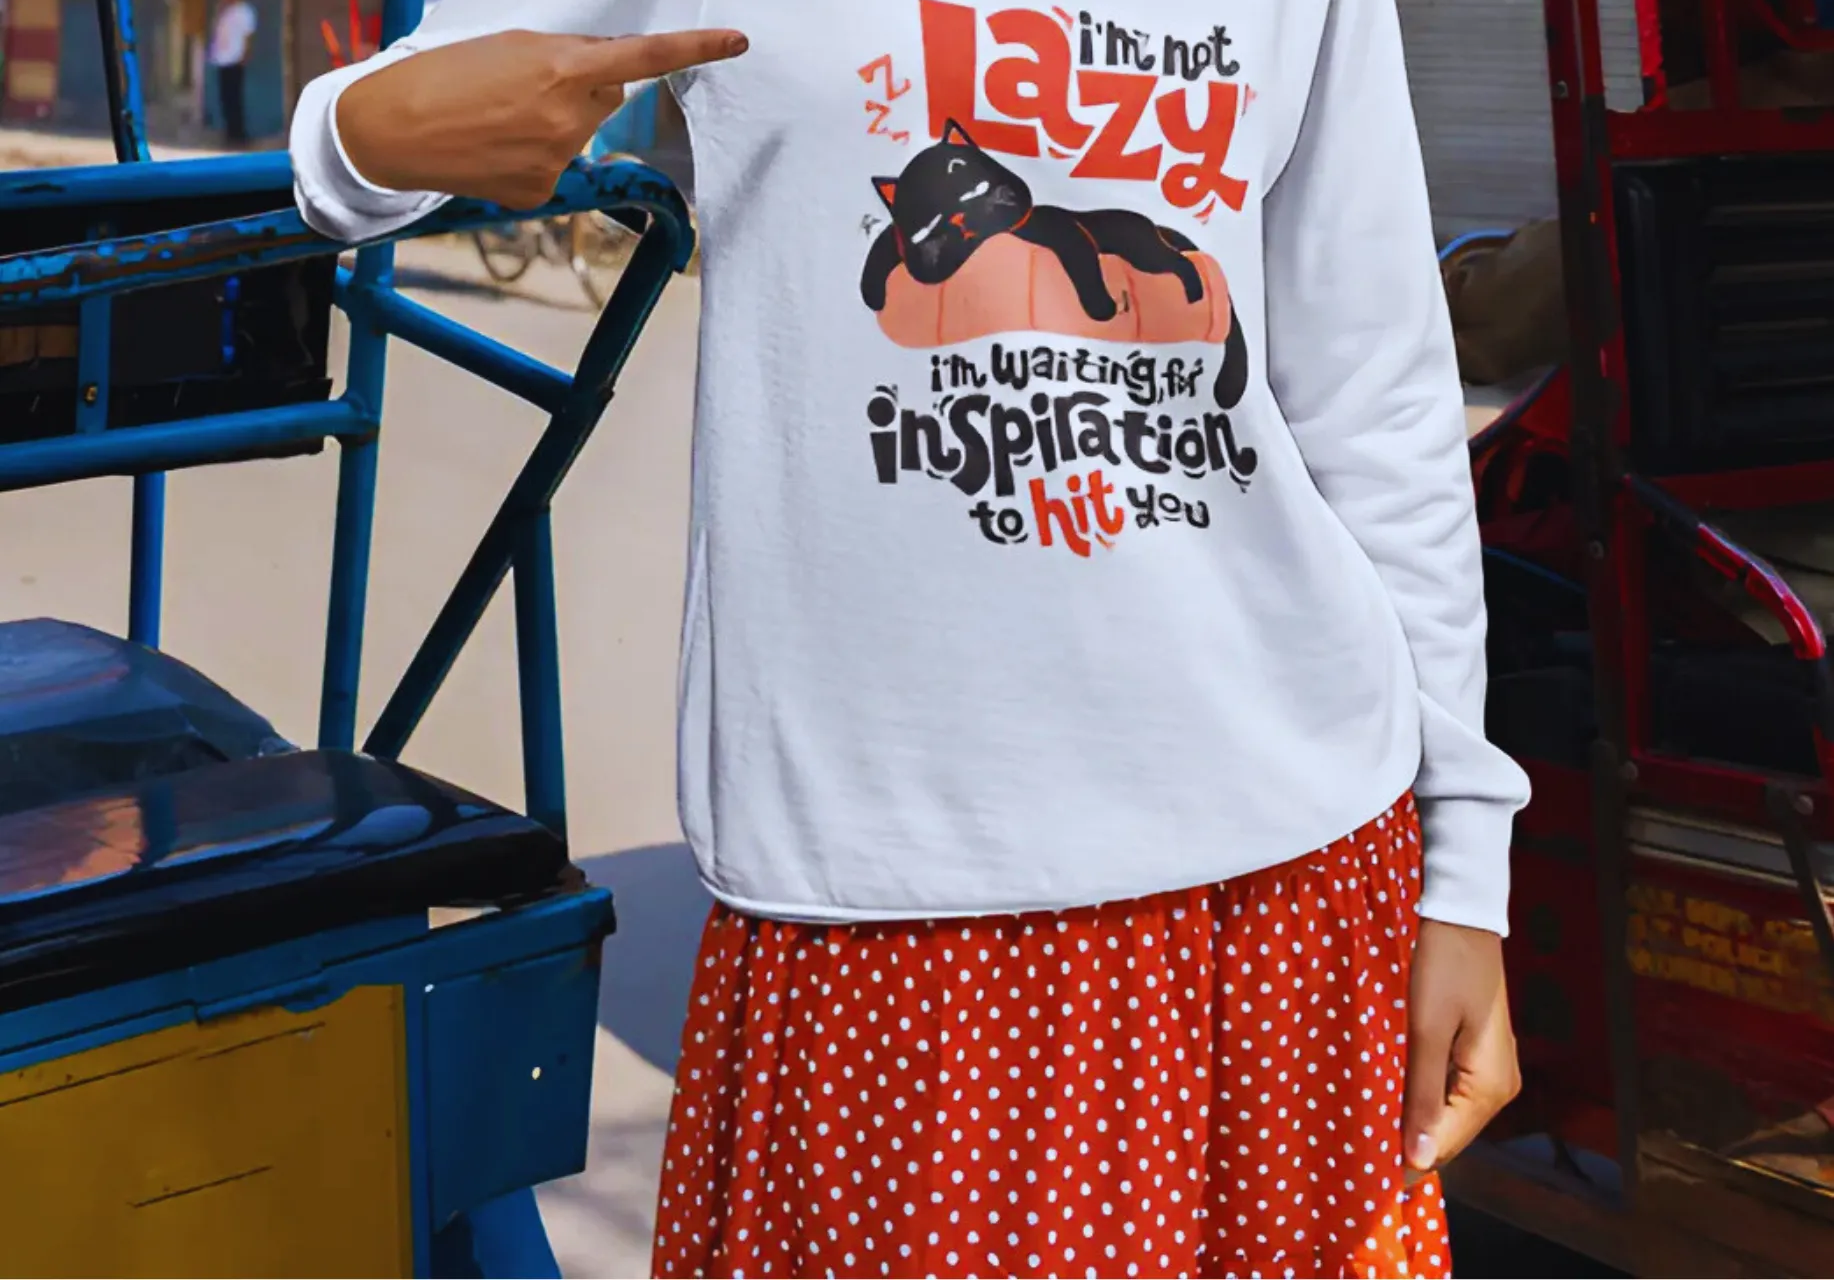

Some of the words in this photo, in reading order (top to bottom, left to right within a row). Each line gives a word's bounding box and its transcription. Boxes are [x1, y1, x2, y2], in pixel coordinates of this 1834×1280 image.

[1079, 10, 1155, 71] i'm
[1163, 25, 1240, 81] not
[930, 353, 987, 392] i'm
[990, 342, 1157, 406] waiting
[968, 500, 1026, 545] to
[1028, 469, 1125, 557] hit
[1125, 483, 1211, 529] you
